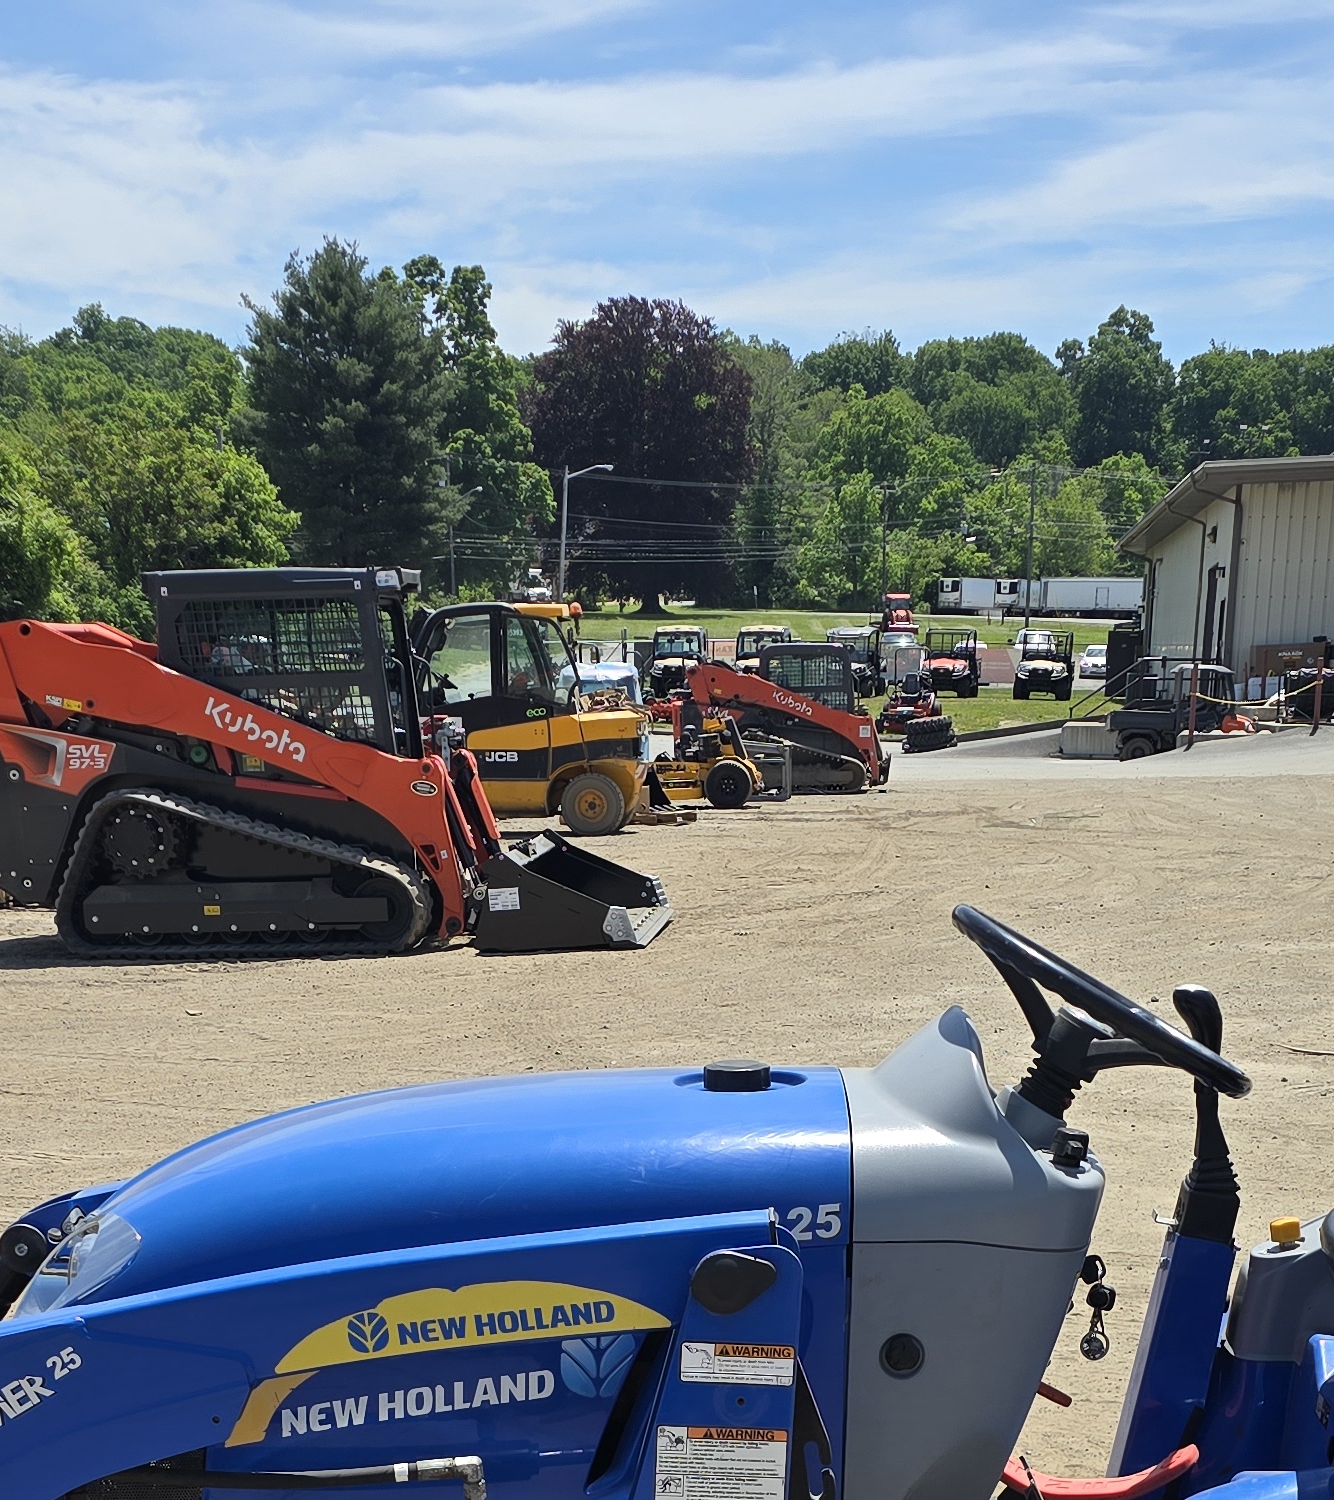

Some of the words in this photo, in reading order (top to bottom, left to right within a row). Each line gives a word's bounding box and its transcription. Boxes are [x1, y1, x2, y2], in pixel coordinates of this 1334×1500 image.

[526, 707, 547, 718] eco
[772, 690, 813, 716] Kubota
[204, 696, 306, 763] Kubota
[67, 744, 107, 758] SVL
[485, 751, 519, 762] JCB
[786, 1203, 841, 1240] 25
[397, 1315, 467, 1345] NEW
[474, 1300, 616, 1336] HOLLAND
[46, 1346, 83, 1380] 25
[731, 1345, 792, 1358] WARNING
[281, 1395, 369, 1438] NEW
[378, 1369, 555, 1422] HOLLAND
[715, 1428, 775, 1441] WARNING
